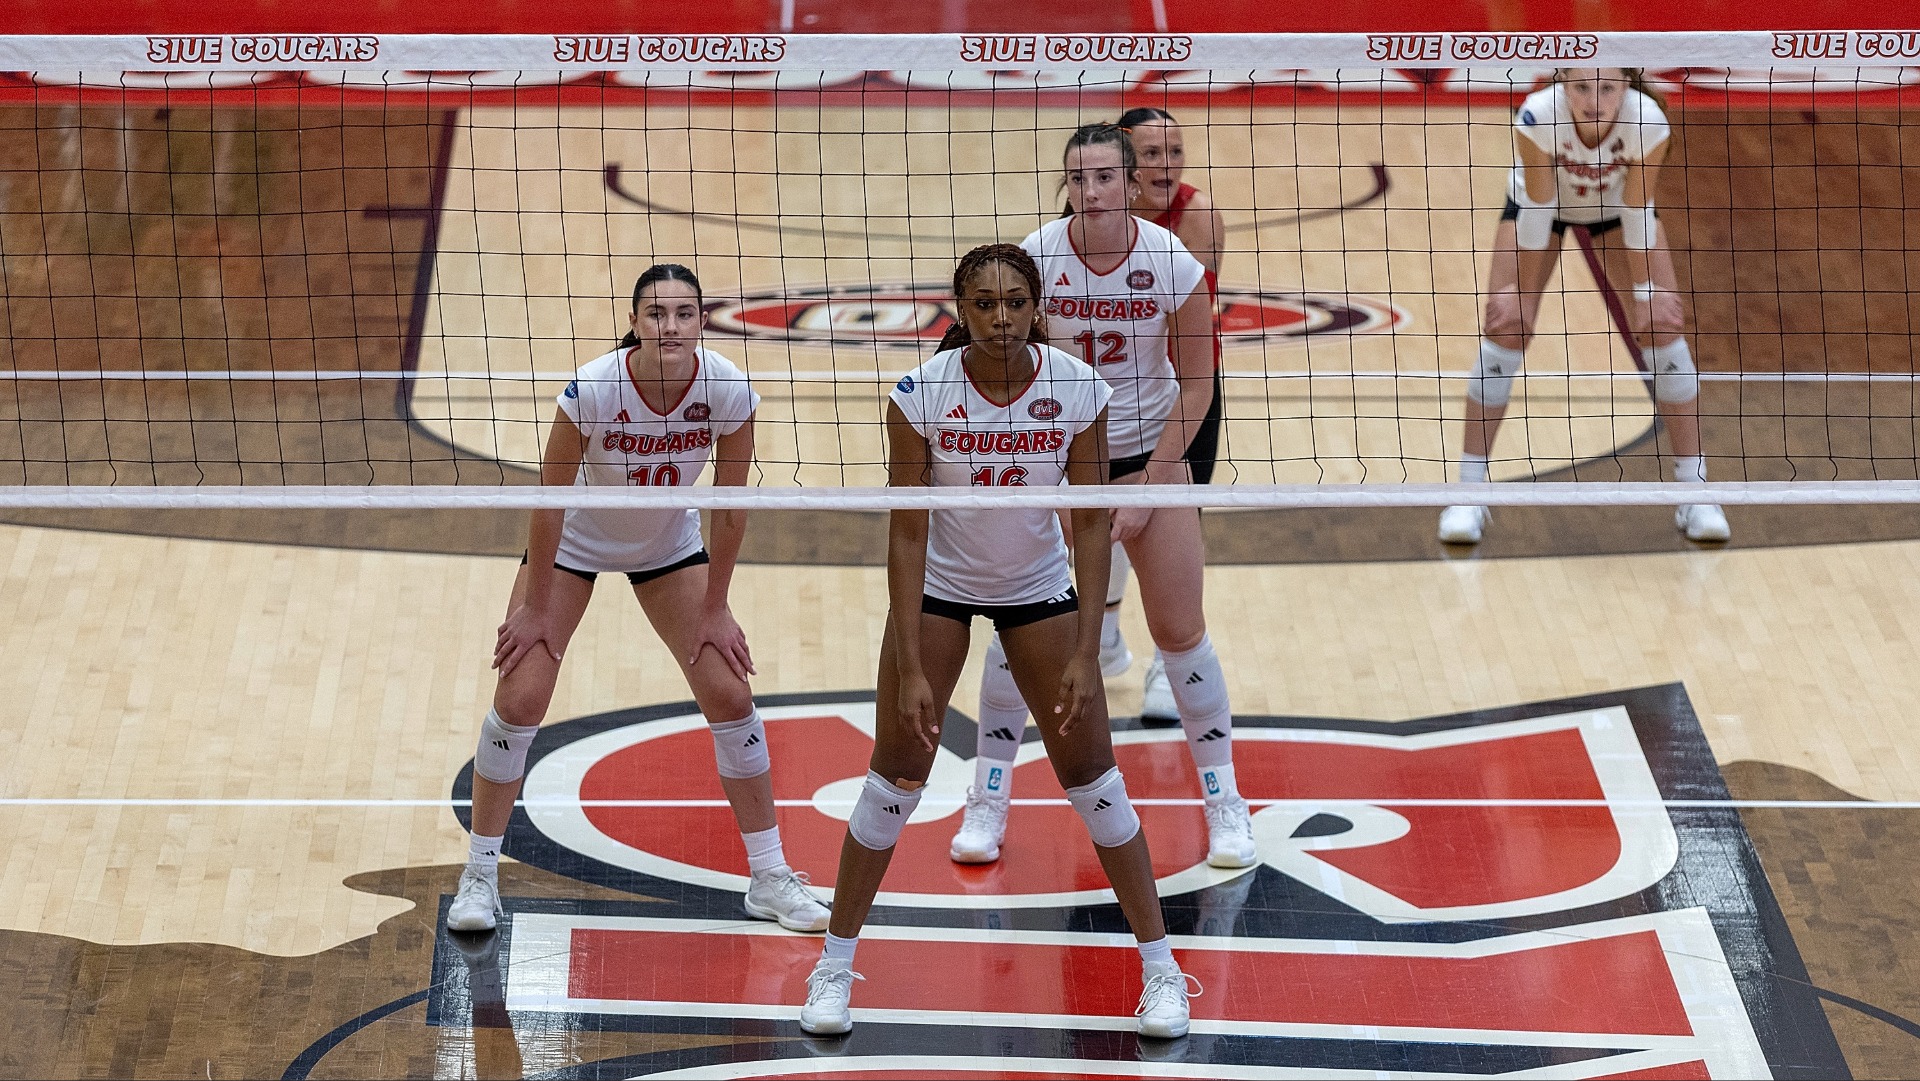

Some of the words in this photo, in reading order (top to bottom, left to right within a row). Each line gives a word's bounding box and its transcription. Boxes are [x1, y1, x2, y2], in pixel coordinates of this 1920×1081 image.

[147, 36, 223, 64] SIUE
[230, 36, 380, 63] COUGARS
[554, 36, 629, 63] SIUE
[638, 36, 786, 63] COUGARS
[960, 36, 1036, 63] SIUE
[1044, 36, 1192, 62] COUGARS
[1366, 34, 1443, 61] SIUE
[1450, 34, 1599, 60] COUGARS
[1771, 32, 1847, 58] SIUE
[1047, 297, 1160, 321] COUGARS
[1074, 330, 1128, 367] 12
[602, 428, 713, 456] COUGARS
[937, 427, 1066, 455] COUGARS
